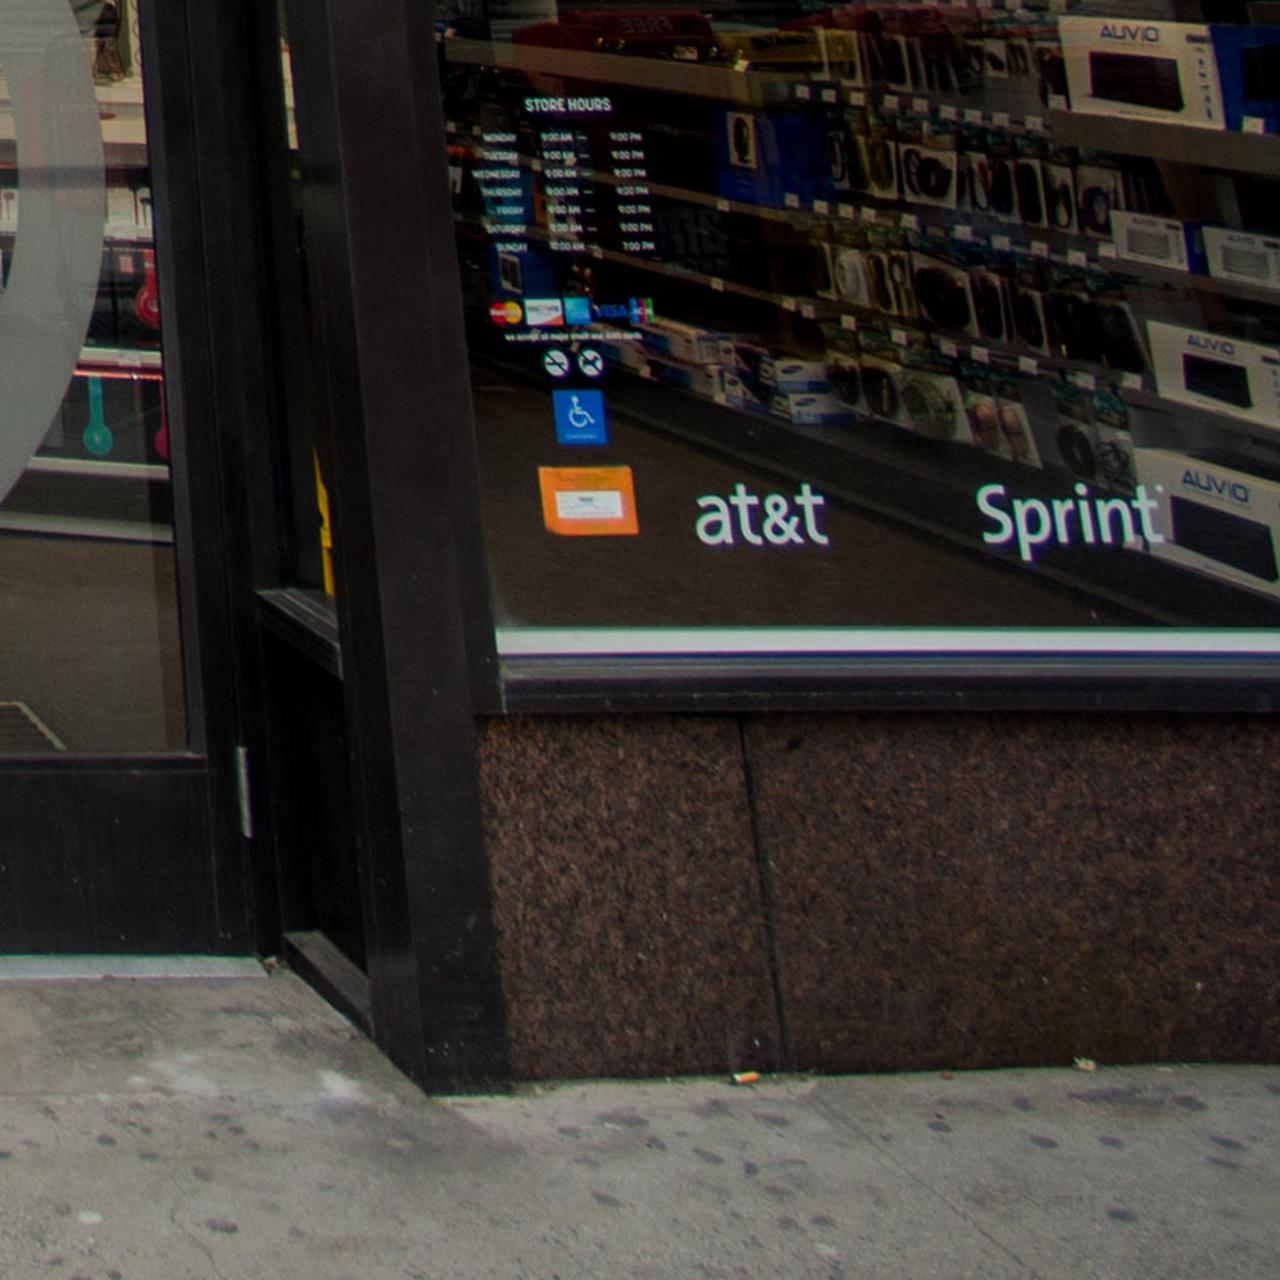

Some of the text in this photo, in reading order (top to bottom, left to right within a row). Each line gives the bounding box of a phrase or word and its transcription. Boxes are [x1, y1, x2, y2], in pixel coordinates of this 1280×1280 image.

[1099, 23, 1160, 42] AUVIO
[525, 96, 613, 113] STORE HOURS
[1181, 468, 1251, 504] AUVIO
[695, 483, 829, 546] at&t
[975, 482, 1167, 562] Sprint
